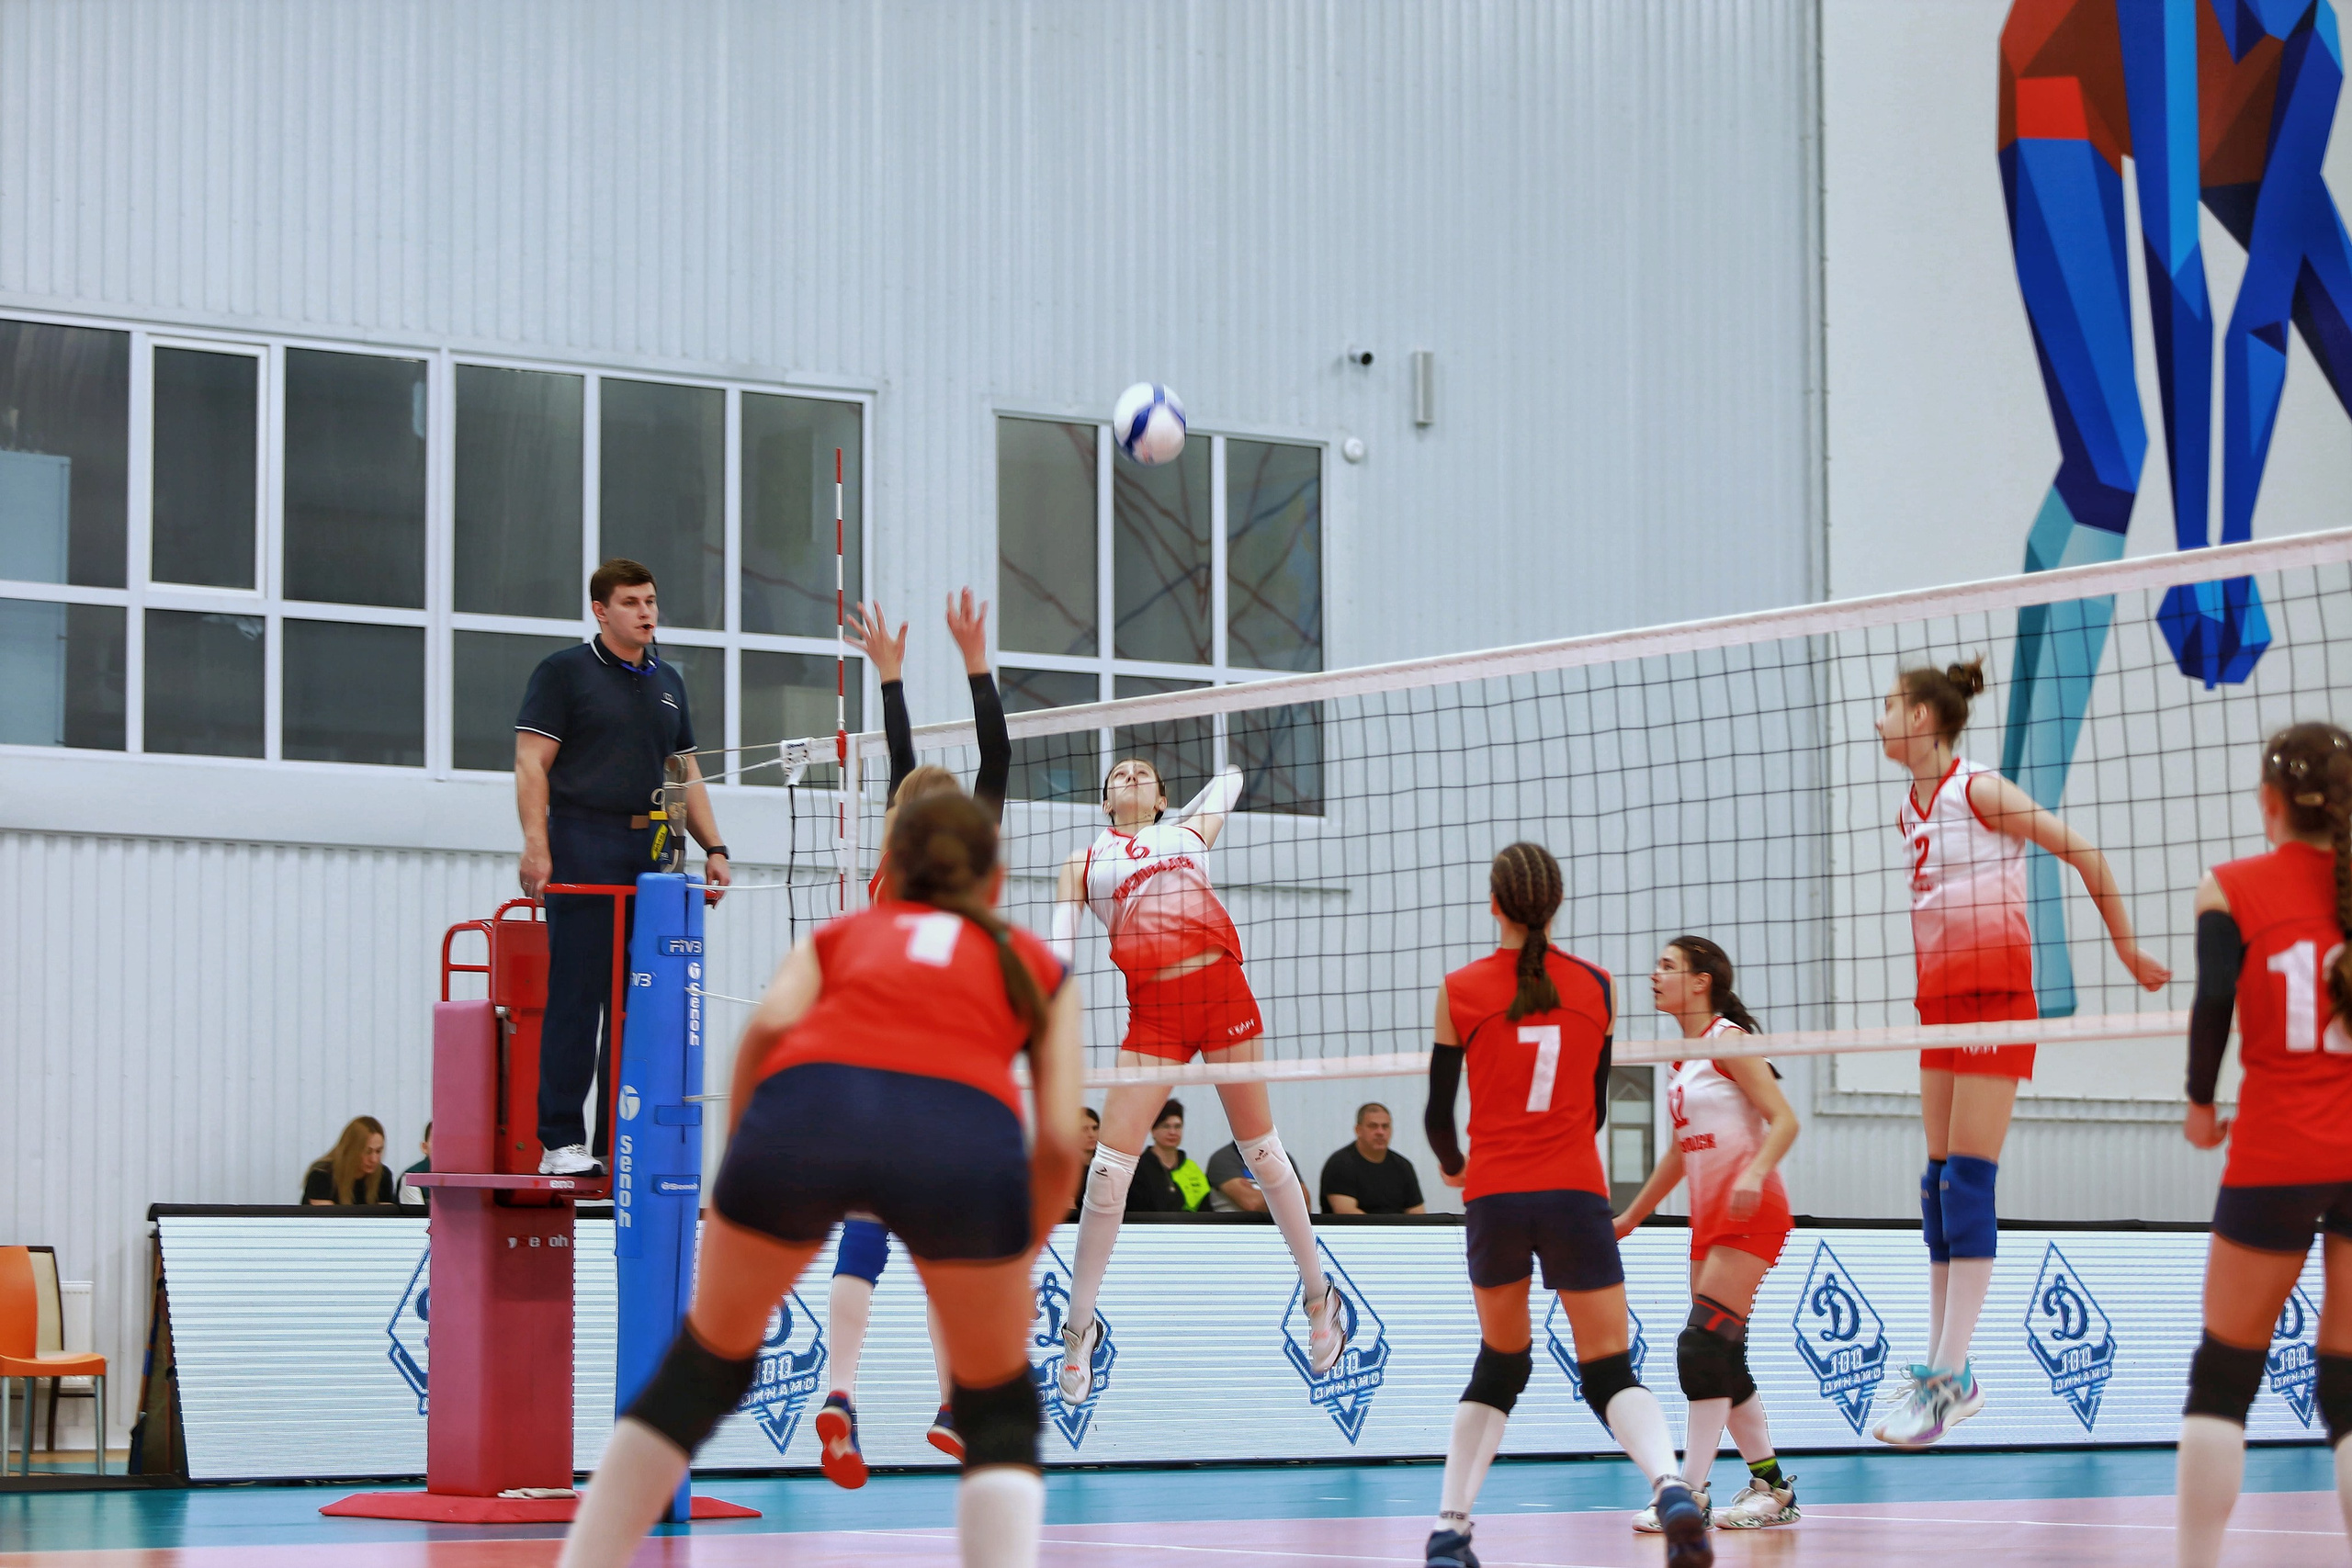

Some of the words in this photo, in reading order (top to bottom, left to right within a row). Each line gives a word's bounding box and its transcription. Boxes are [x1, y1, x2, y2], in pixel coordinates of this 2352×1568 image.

[1125, 836, 1150, 860] 6
[1914, 834, 1930, 883] 2
[895, 912, 964, 967] 1
[1517, 1024, 1561, 1112] 7
